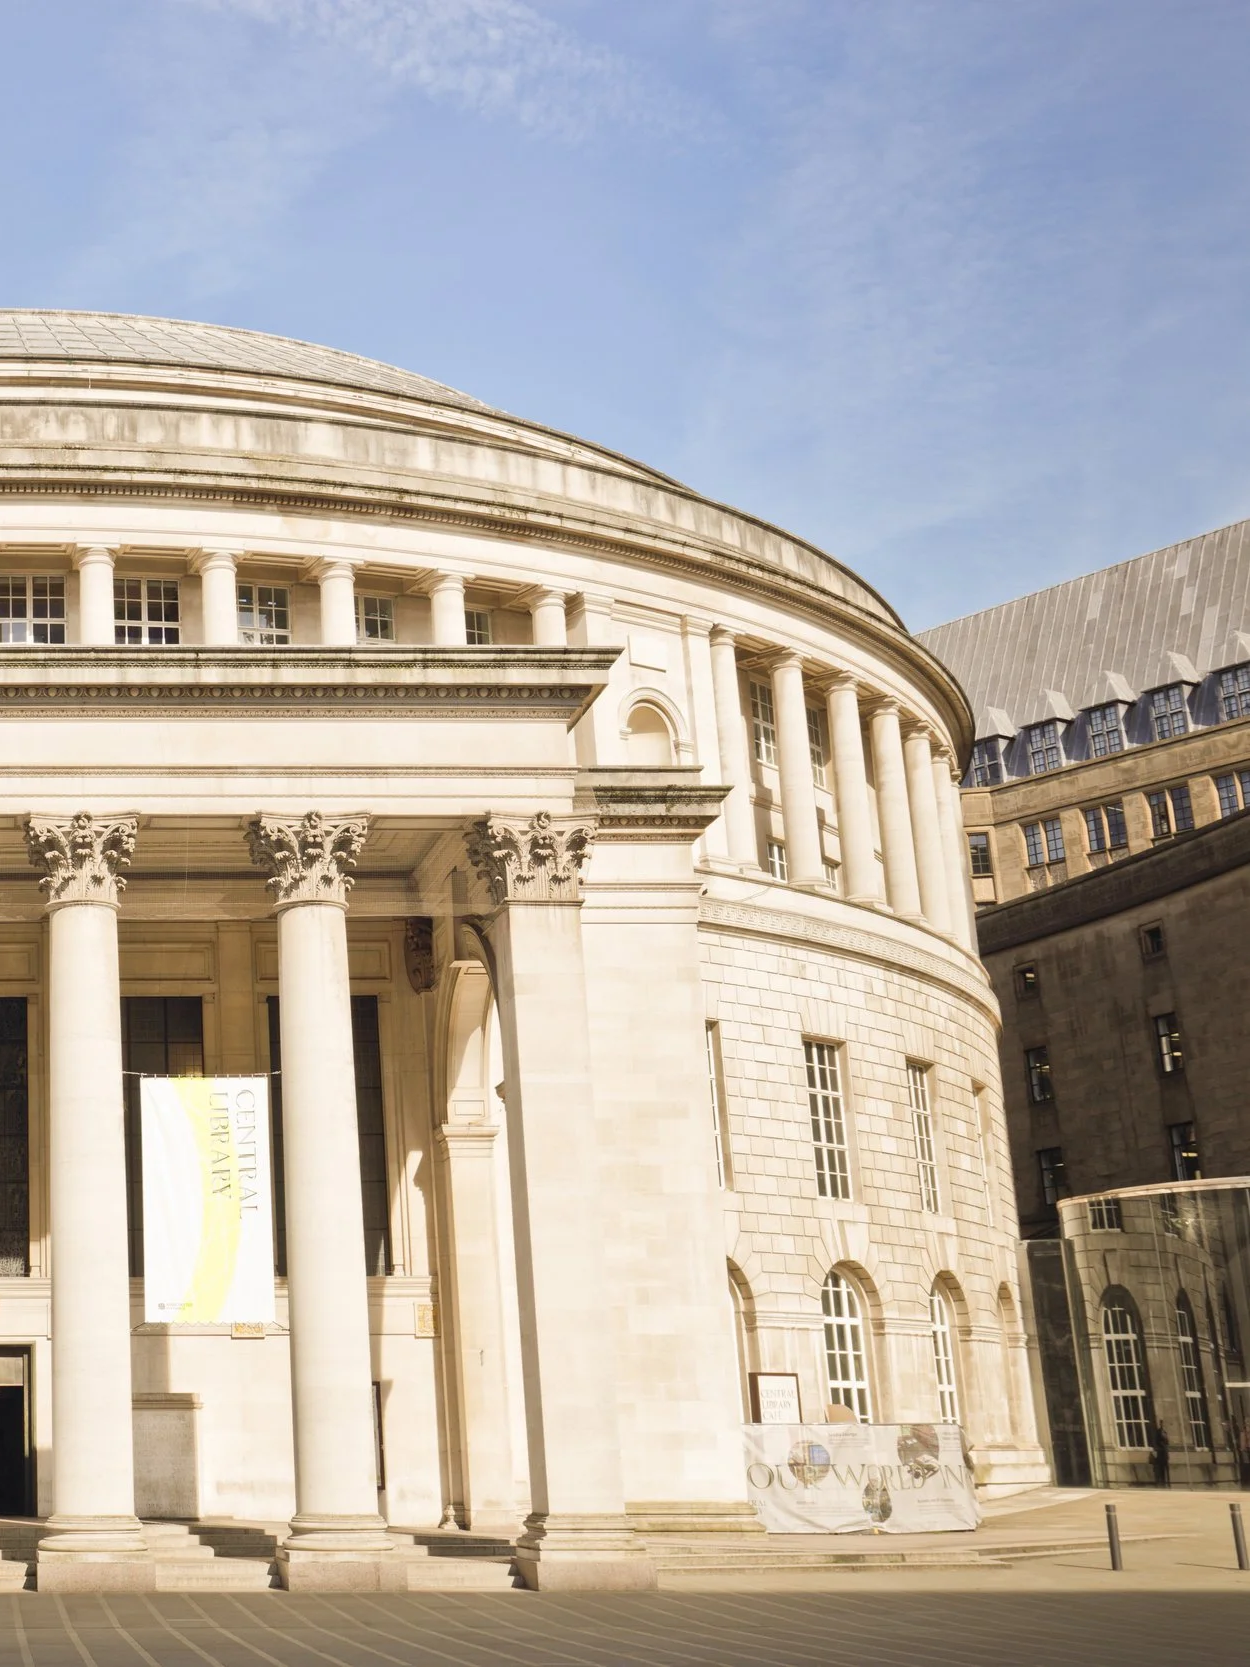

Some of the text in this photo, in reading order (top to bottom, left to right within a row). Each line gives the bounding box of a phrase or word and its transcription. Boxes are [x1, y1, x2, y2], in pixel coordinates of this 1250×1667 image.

[209, 1092, 232, 1199] LIBRARY
[235, 1089, 258, 1220] CENTRAL
[746, 1462, 821, 1490] OUR
[830, 1463, 926, 1491] WORLD
